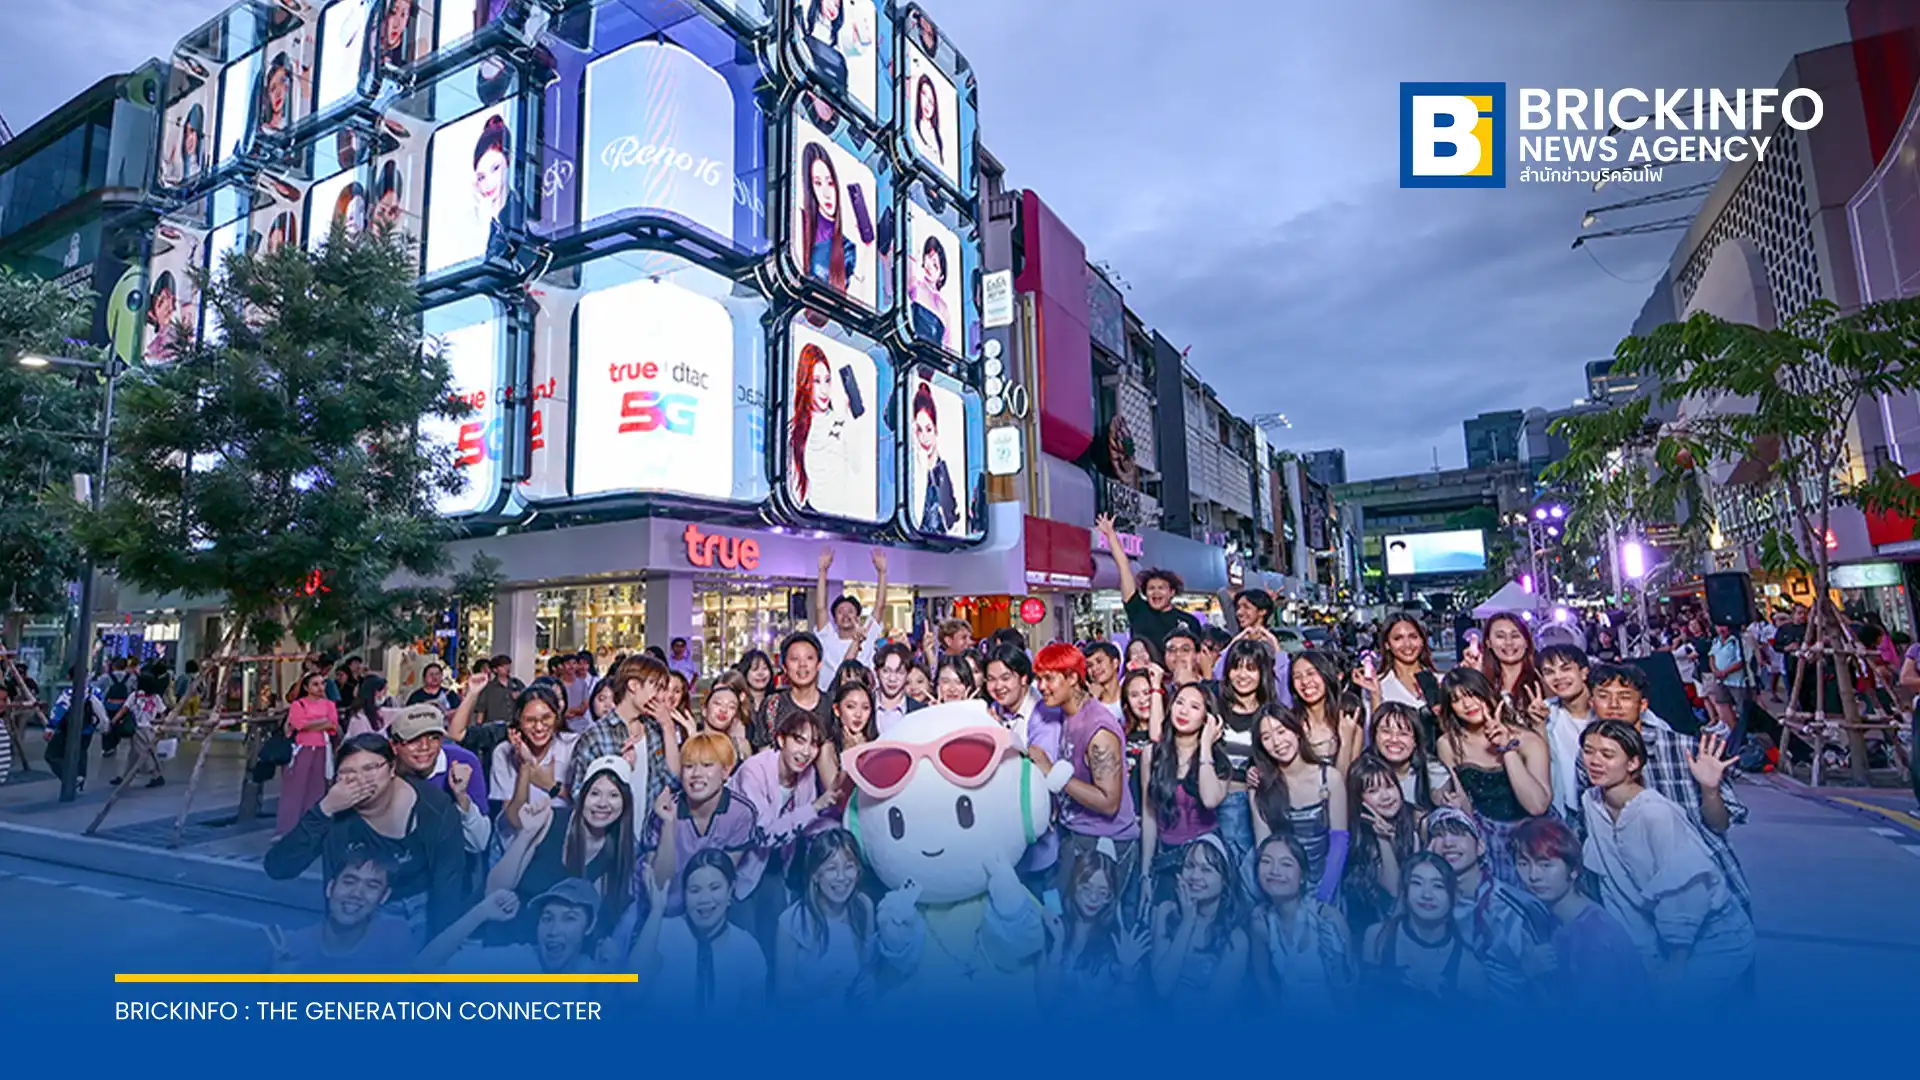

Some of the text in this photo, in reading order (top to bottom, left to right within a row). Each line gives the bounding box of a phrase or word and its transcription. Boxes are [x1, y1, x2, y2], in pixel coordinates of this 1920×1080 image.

[601, 135, 724, 187] Reno 16
[608, 361, 709, 390] true dtac
[618, 390, 699, 436] 5G
[684, 523, 760, 570] true
